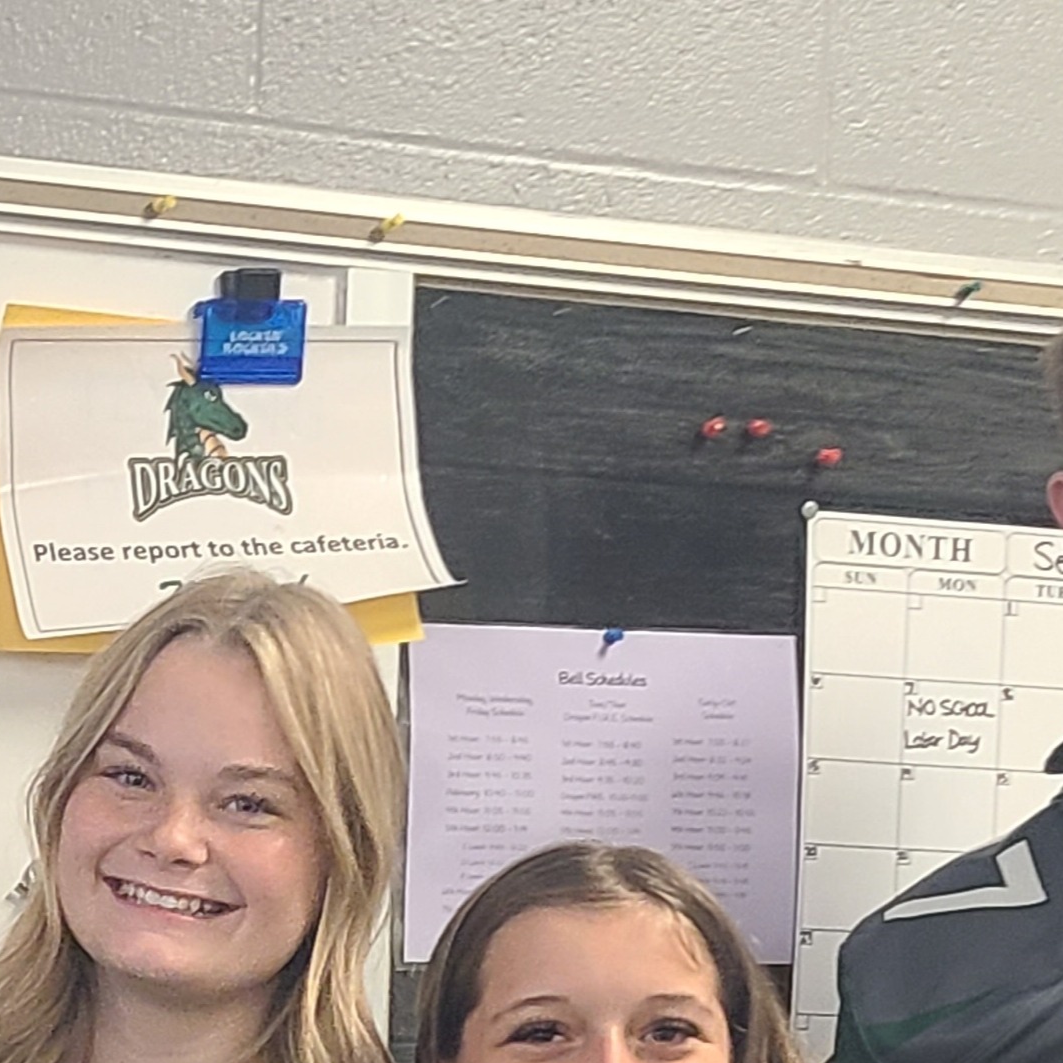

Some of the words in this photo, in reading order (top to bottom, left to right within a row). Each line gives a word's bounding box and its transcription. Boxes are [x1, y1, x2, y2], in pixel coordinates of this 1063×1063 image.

[128, 455, 293, 521] DRAGONS
[33, 542, 116, 562] Please
[122, 541, 203, 564] report
[207, 541, 235, 557] to
[241, 537, 284, 556] the
[290, 533, 409, 554] cafeteria.
[848, 529, 973, 563] MONTH
[844, 571, 877, 585] SUN
[939, 577, 978, 592] MON
[558, 670, 584, 685] Bell
[585, 671, 648, 687] Schedules
[906, 698, 936, 716] NO
[947, 728, 981, 754] Day
